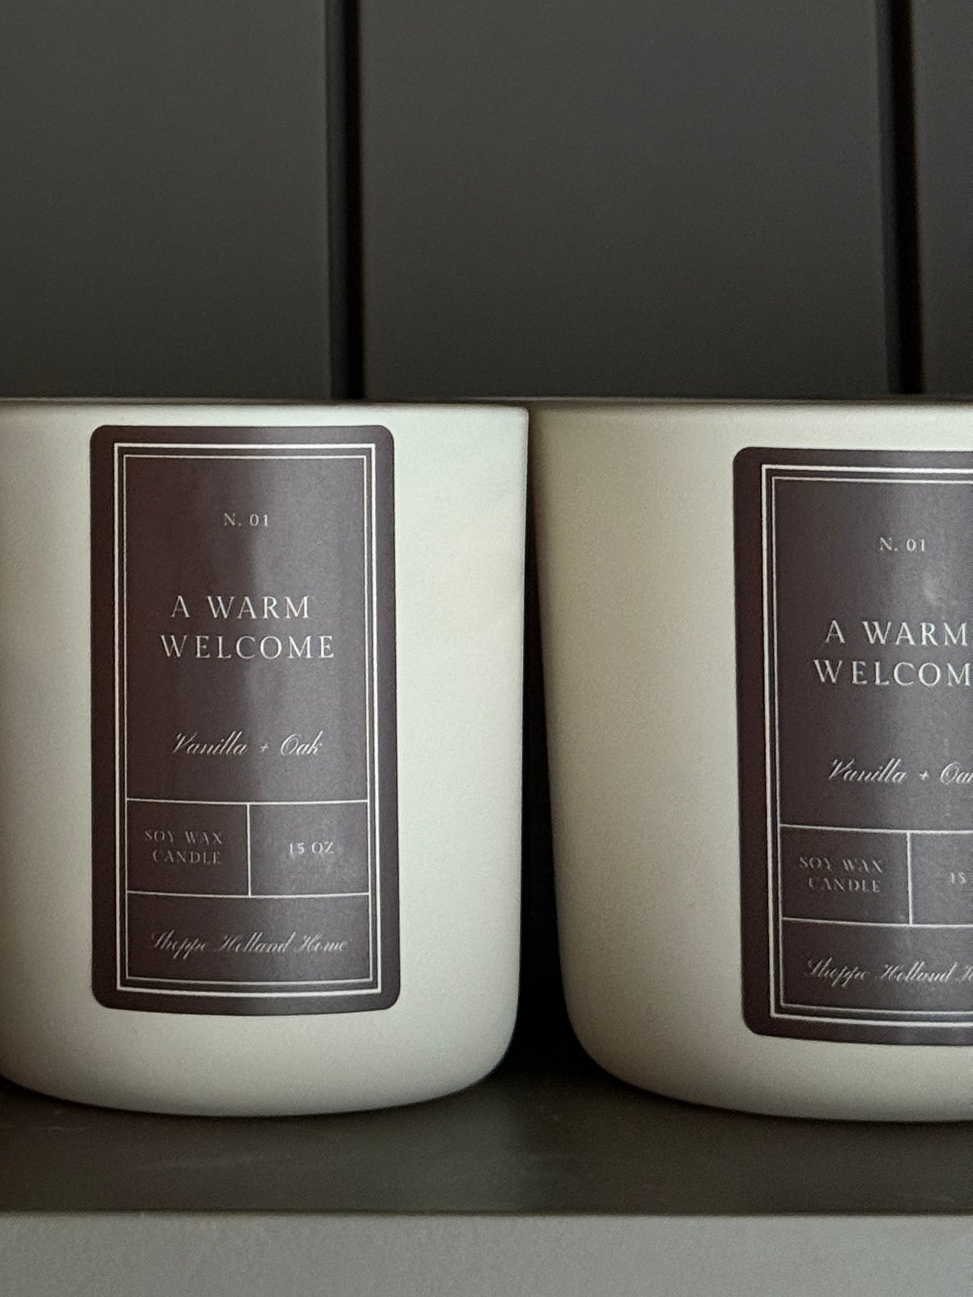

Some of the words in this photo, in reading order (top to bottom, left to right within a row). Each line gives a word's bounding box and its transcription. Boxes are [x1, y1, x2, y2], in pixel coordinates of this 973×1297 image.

[223, 513, 242, 527] N.
[249, 514, 269, 527] 01
[879, 537, 898, 551] N.
[906, 538, 926, 552] 01
[171, 595, 190, 618] A
[206, 595, 310, 619] WARM
[824, 619, 846, 644] A
[862, 621, 968, 646] WARM
[160, 634, 335, 659] WELCOME
[813, 658, 971, 686] WELCOM
[173, 730, 247, 755] Vanilla
[280, 730, 324, 755] Oak
[828, 757, 908, 784] Vanilla
[939, 761, 973, 784] Oa
[144, 830, 175, 844] SOY
[185, 831, 223, 845] WAX
[152, 851, 222, 865] CANDLE
[289, 842, 305, 857] 15
[311, 841, 335, 855] OZ
[799, 857, 832, 870] SOY
[843, 858, 883, 874] WAX
[808, 878, 881, 893] CANDLE
[950, 872, 966, 884] 15
[218, 931, 297, 953] Holland
[295, 933, 348, 953] Home
[878, 960, 959, 983] Holland
